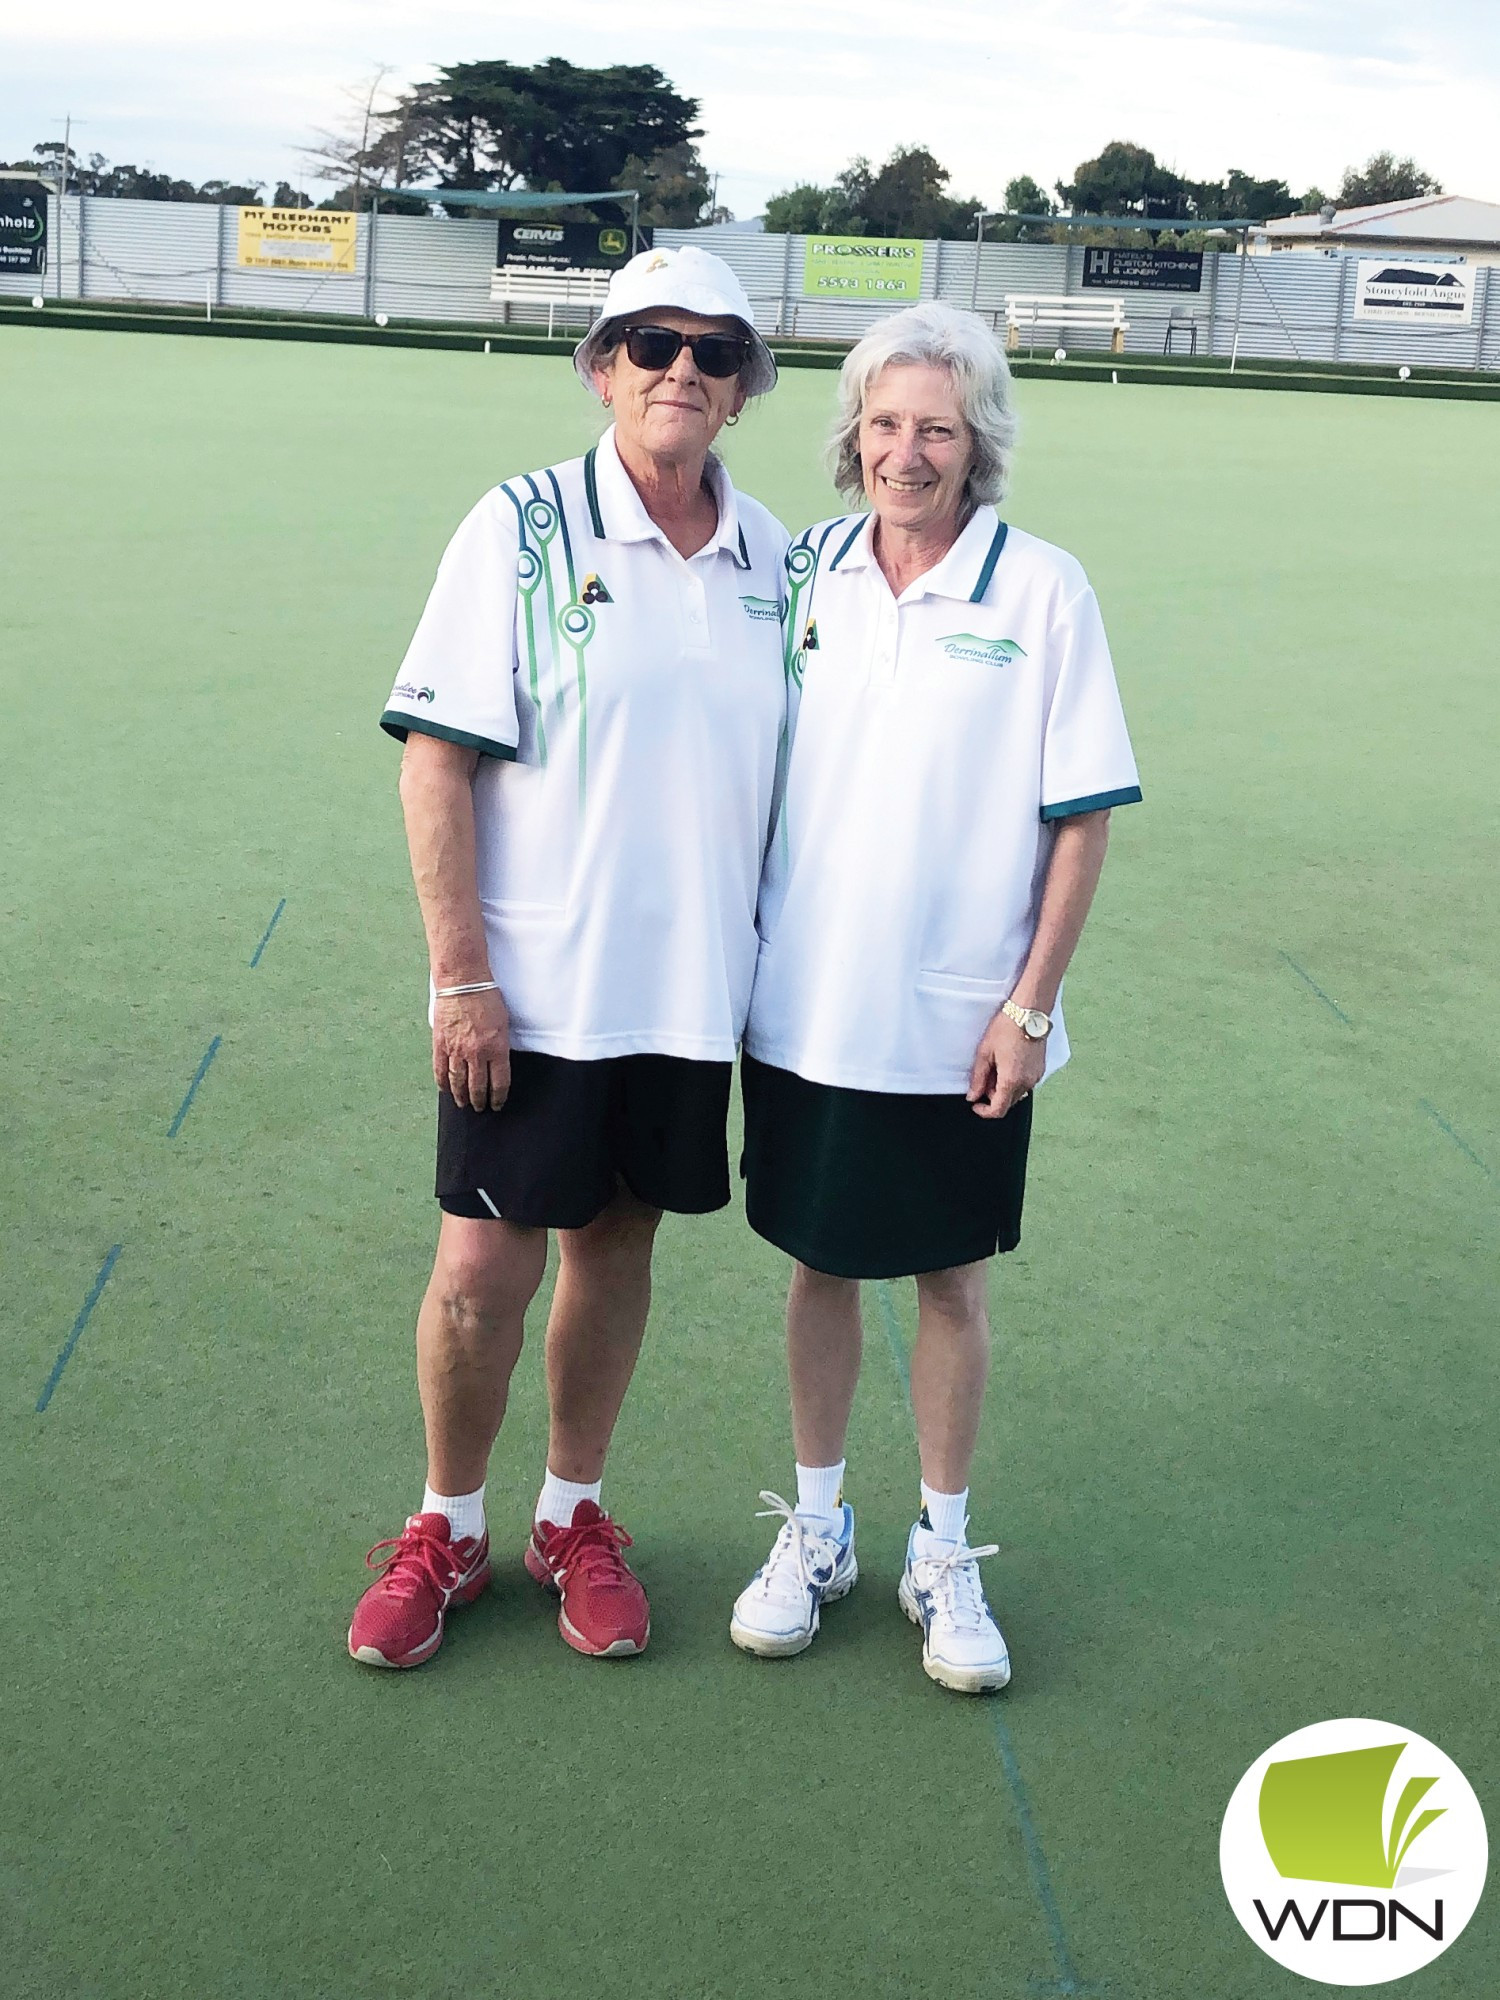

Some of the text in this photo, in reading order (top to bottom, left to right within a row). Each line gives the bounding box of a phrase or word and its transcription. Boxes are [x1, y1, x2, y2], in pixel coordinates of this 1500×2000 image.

[244, 211, 351, 225] MT ELEPHANT
[262, 222, 332, 234] MOTORS
[513, 228, 564, 241] CERVUS
[812, 243, 917, 258] PROSSER'S
[1089, 250, 1110, 275] H
[1113, 259, 1199, 271] CUSTOM KITCHENS
[1122, 268, 1160, 276] JOINERY
[818, 276, 907, 291] 5593 1863
[1365, 284, 1467, 301] Stoneyfold Angus
[944, 643, 1012, 664] Derrinallum
[949, 654, 1004, 668] BOWLING CLUB
